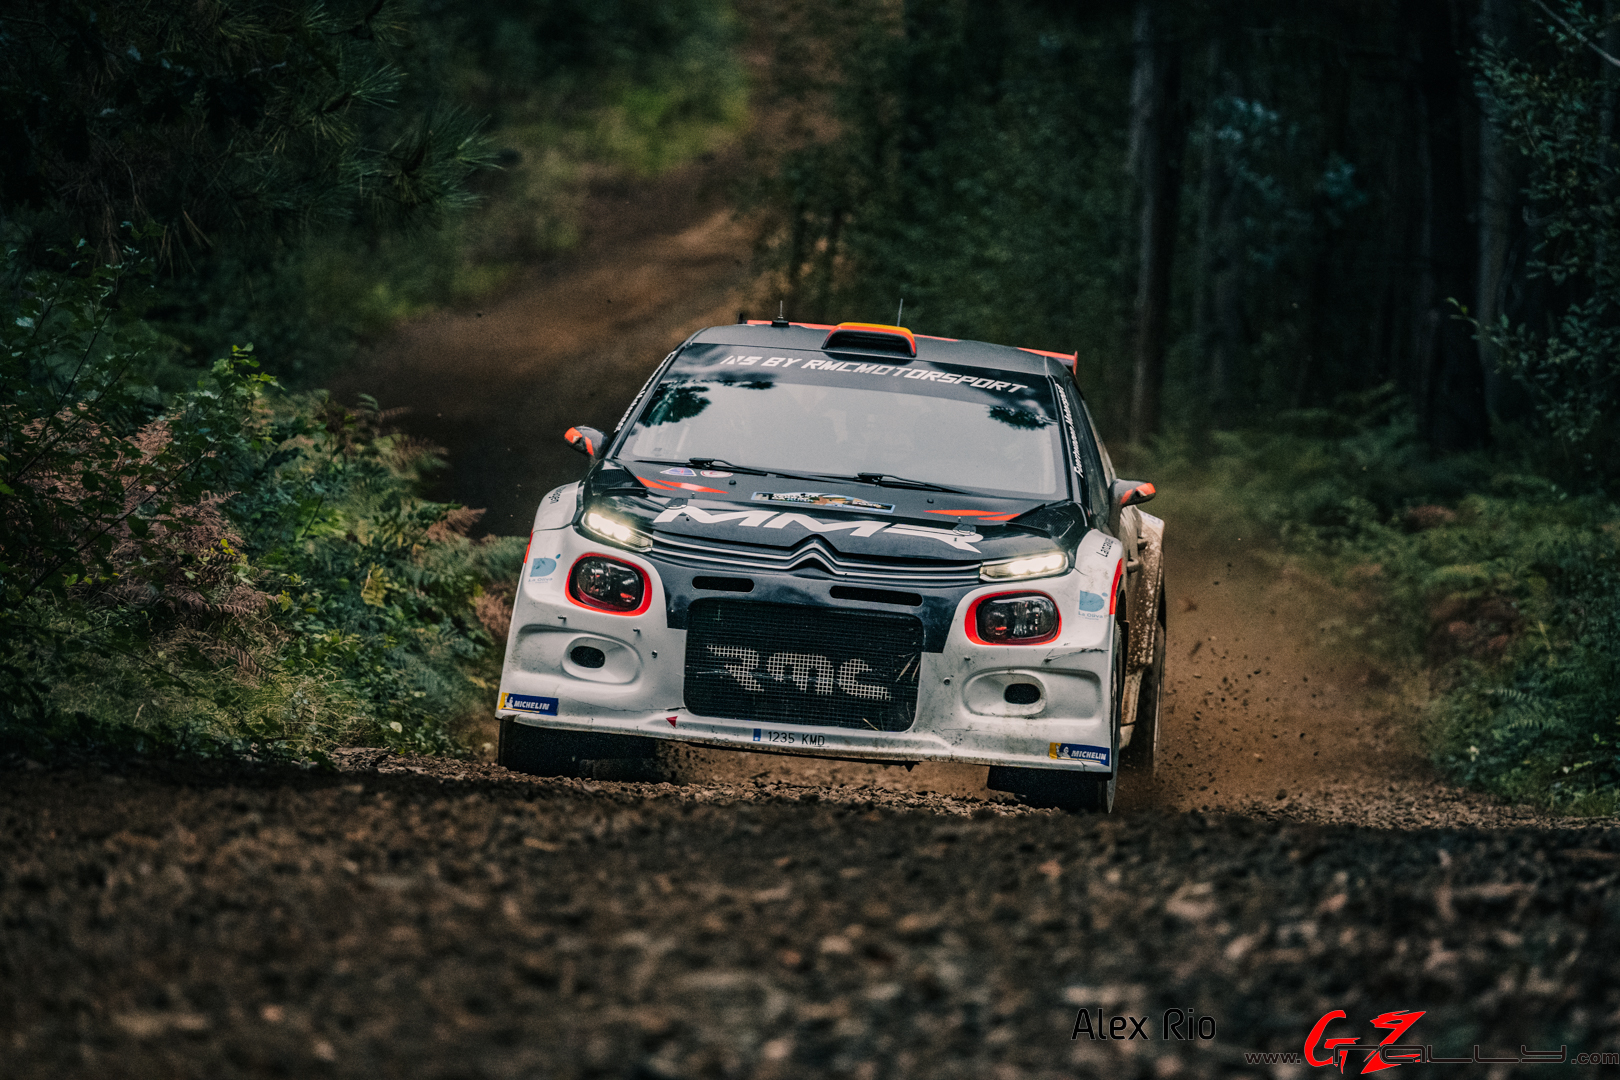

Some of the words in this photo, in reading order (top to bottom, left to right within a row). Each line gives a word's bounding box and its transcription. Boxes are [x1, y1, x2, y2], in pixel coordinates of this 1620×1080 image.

[760, 357, 803, 368] BY
[800, 359, 1028, 393] RMCMOTORSPORT
[652, 505, 984, 554] MMR
[513, 700, 550, 711] MICHELIN
[767, 731, 796, 744] 1235
[801, 733, 826, 746] KMD
[1070, 750, 1107, 761] MICHELIN
